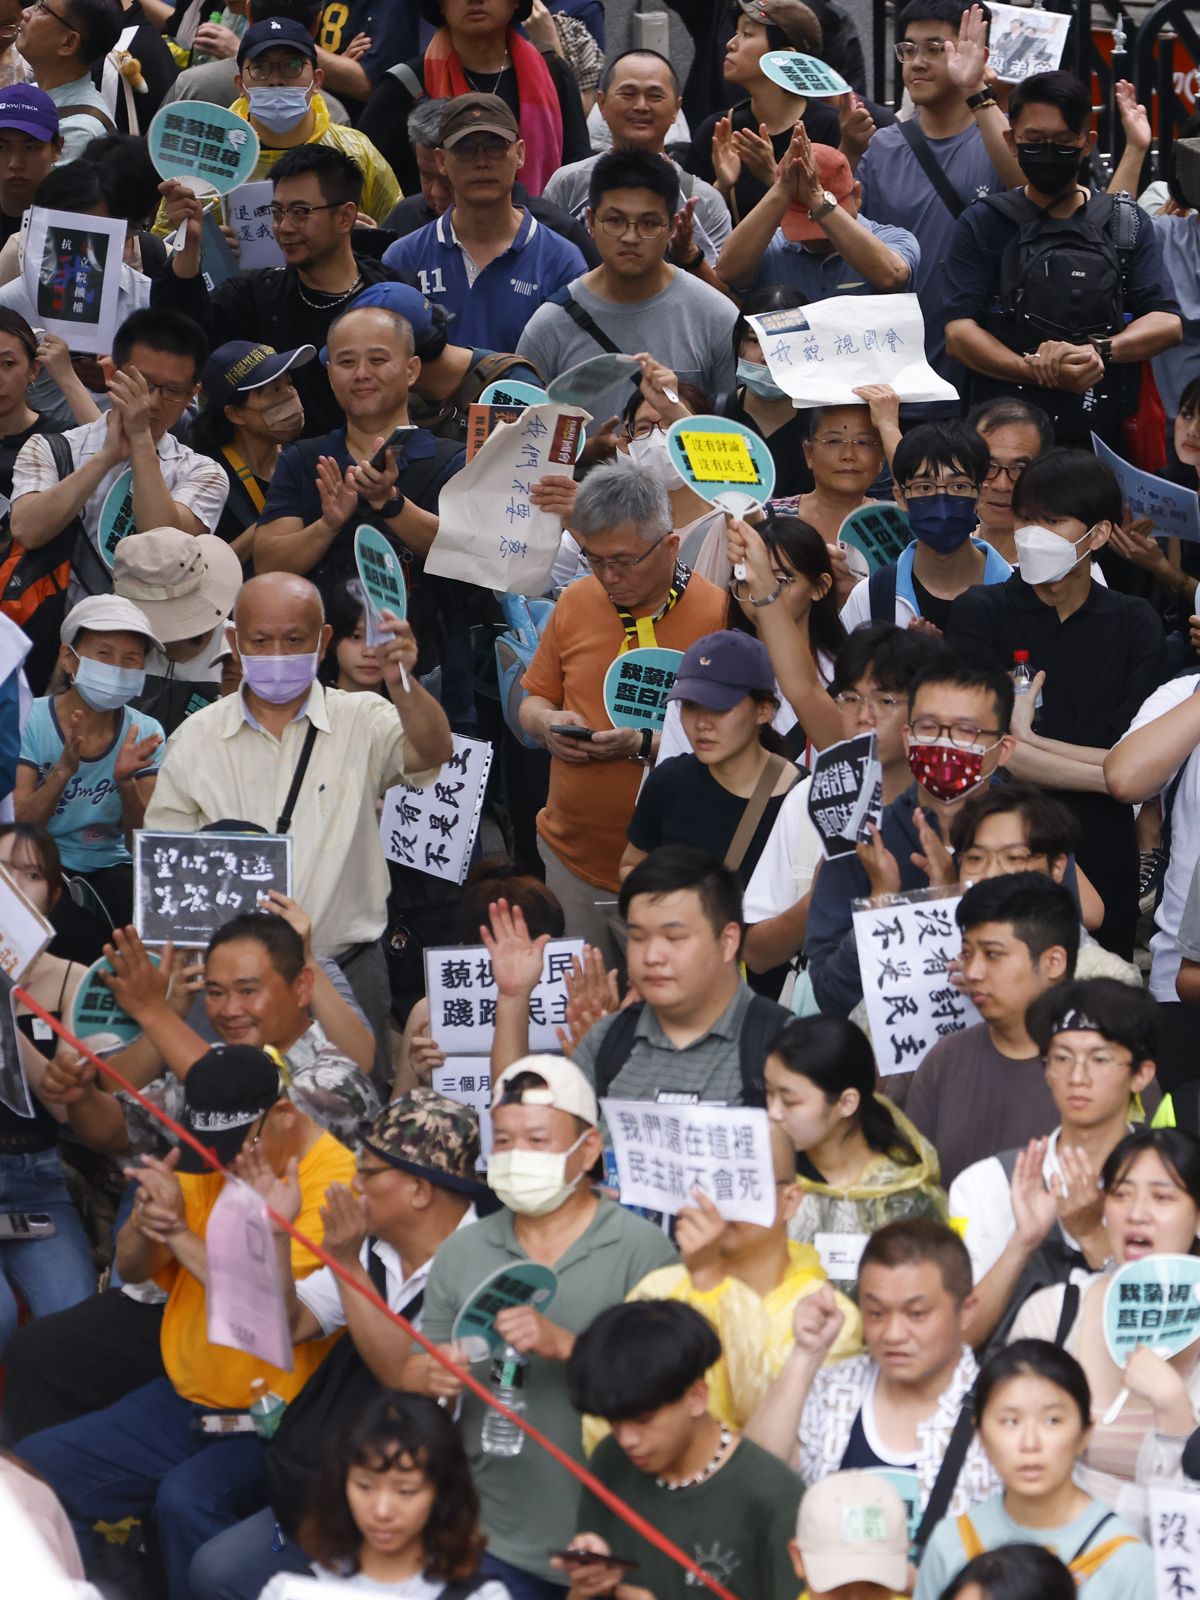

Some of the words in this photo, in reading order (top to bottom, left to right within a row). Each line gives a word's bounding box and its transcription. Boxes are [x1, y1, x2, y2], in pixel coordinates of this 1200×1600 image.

[321, 2, 349, 53] 8
[699, 458, 748, 473] 沒有民主
[440, 952, 577, 990] 藐民
[872, 915, 927, 1065] 不是民主
